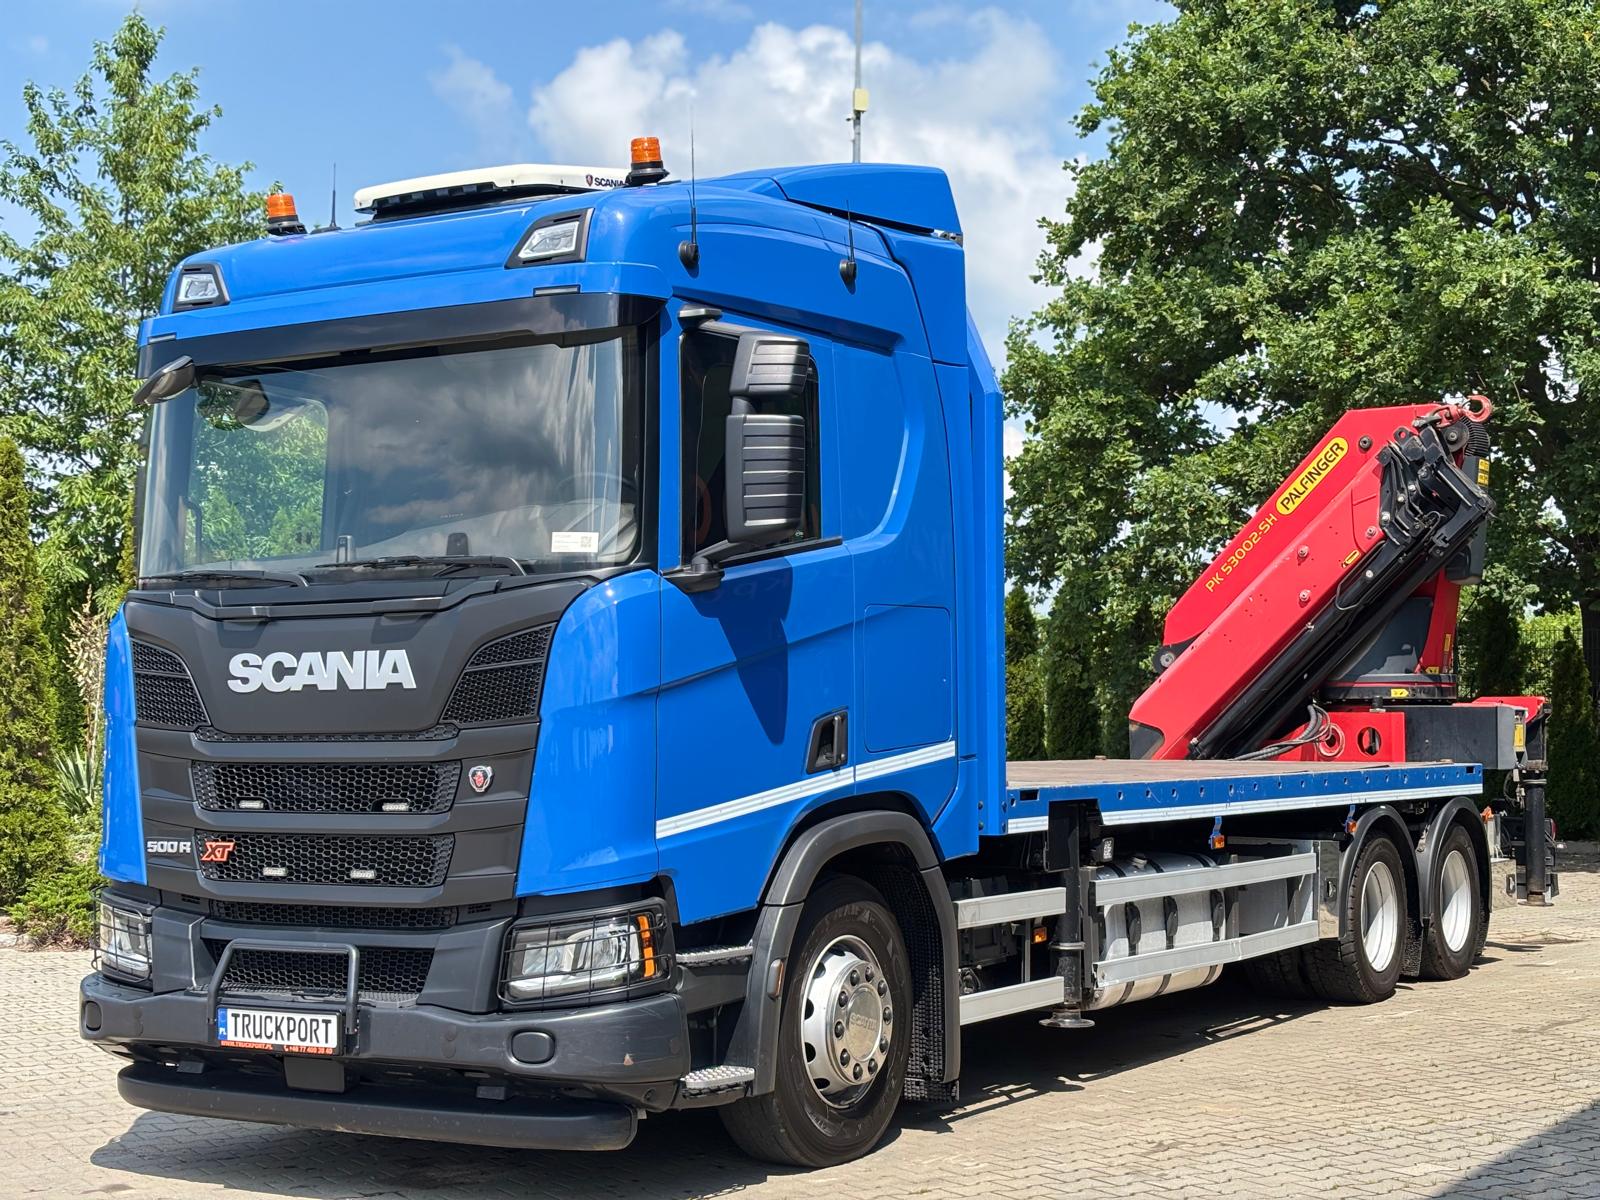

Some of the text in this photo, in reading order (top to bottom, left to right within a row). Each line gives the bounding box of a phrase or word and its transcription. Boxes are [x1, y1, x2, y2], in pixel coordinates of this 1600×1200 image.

[1280, 442, 1345, 511] PALFINGER
[1205, 513, 1278, 592] PK 53002-SH
[227, 649, 417, 693] SCANIA
[200, 841, 235, 862] XT
[231, 1013, 332, 1044] TRUCKPORT
